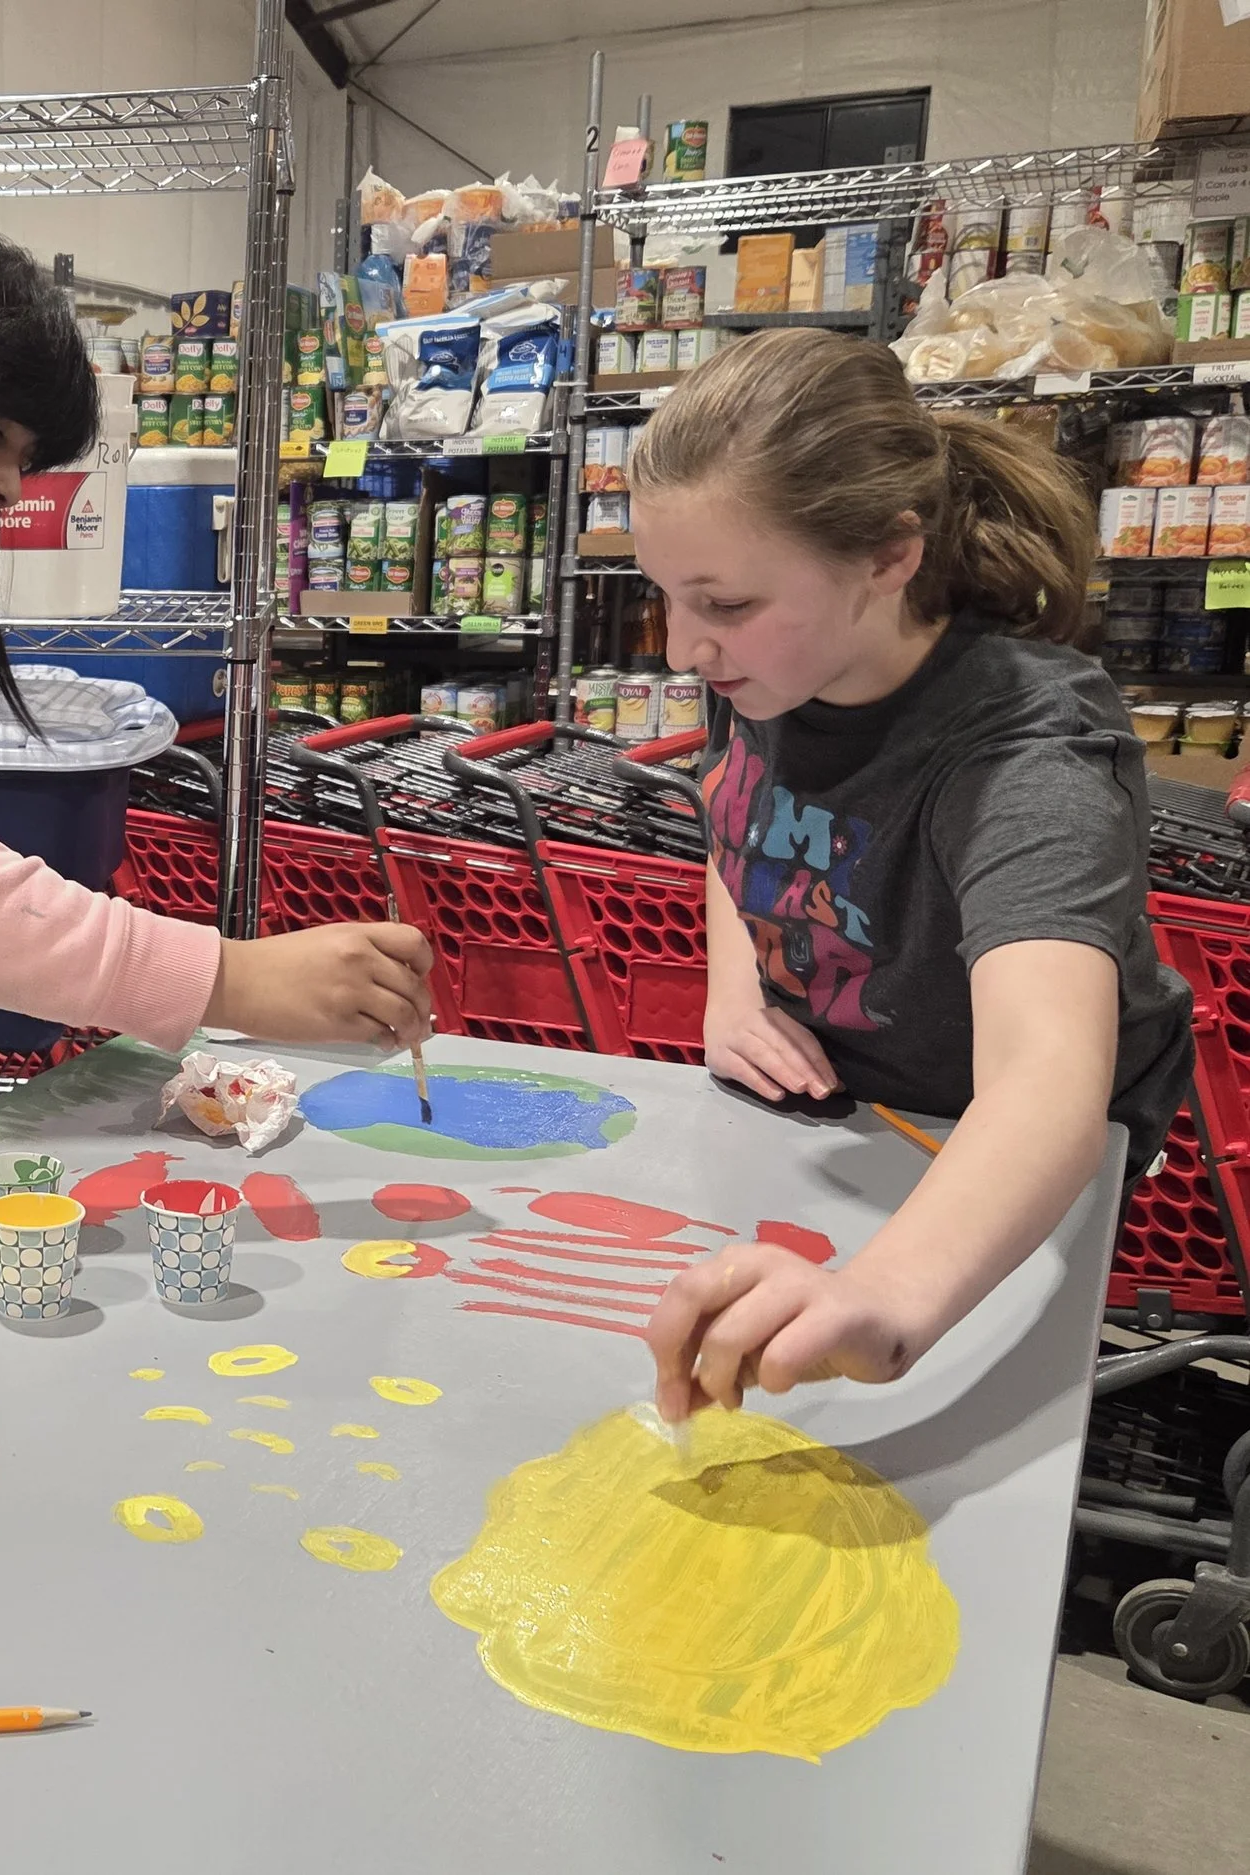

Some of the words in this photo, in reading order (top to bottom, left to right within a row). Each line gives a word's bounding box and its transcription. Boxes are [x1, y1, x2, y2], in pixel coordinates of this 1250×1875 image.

[587, 126, 598, 152] 2
[180, 344, 202, 356] Dolly
[1212, 364, 1236, 373] FRUIT
[1203, 375, 1243, 384] COCKTAIL
[143, 401, 166, 411] Dolly
[70, 514, 102, 524] Benjamin
[75, 523, 98, 532] Moore
[668, 688, 698, 699] ROYAL
